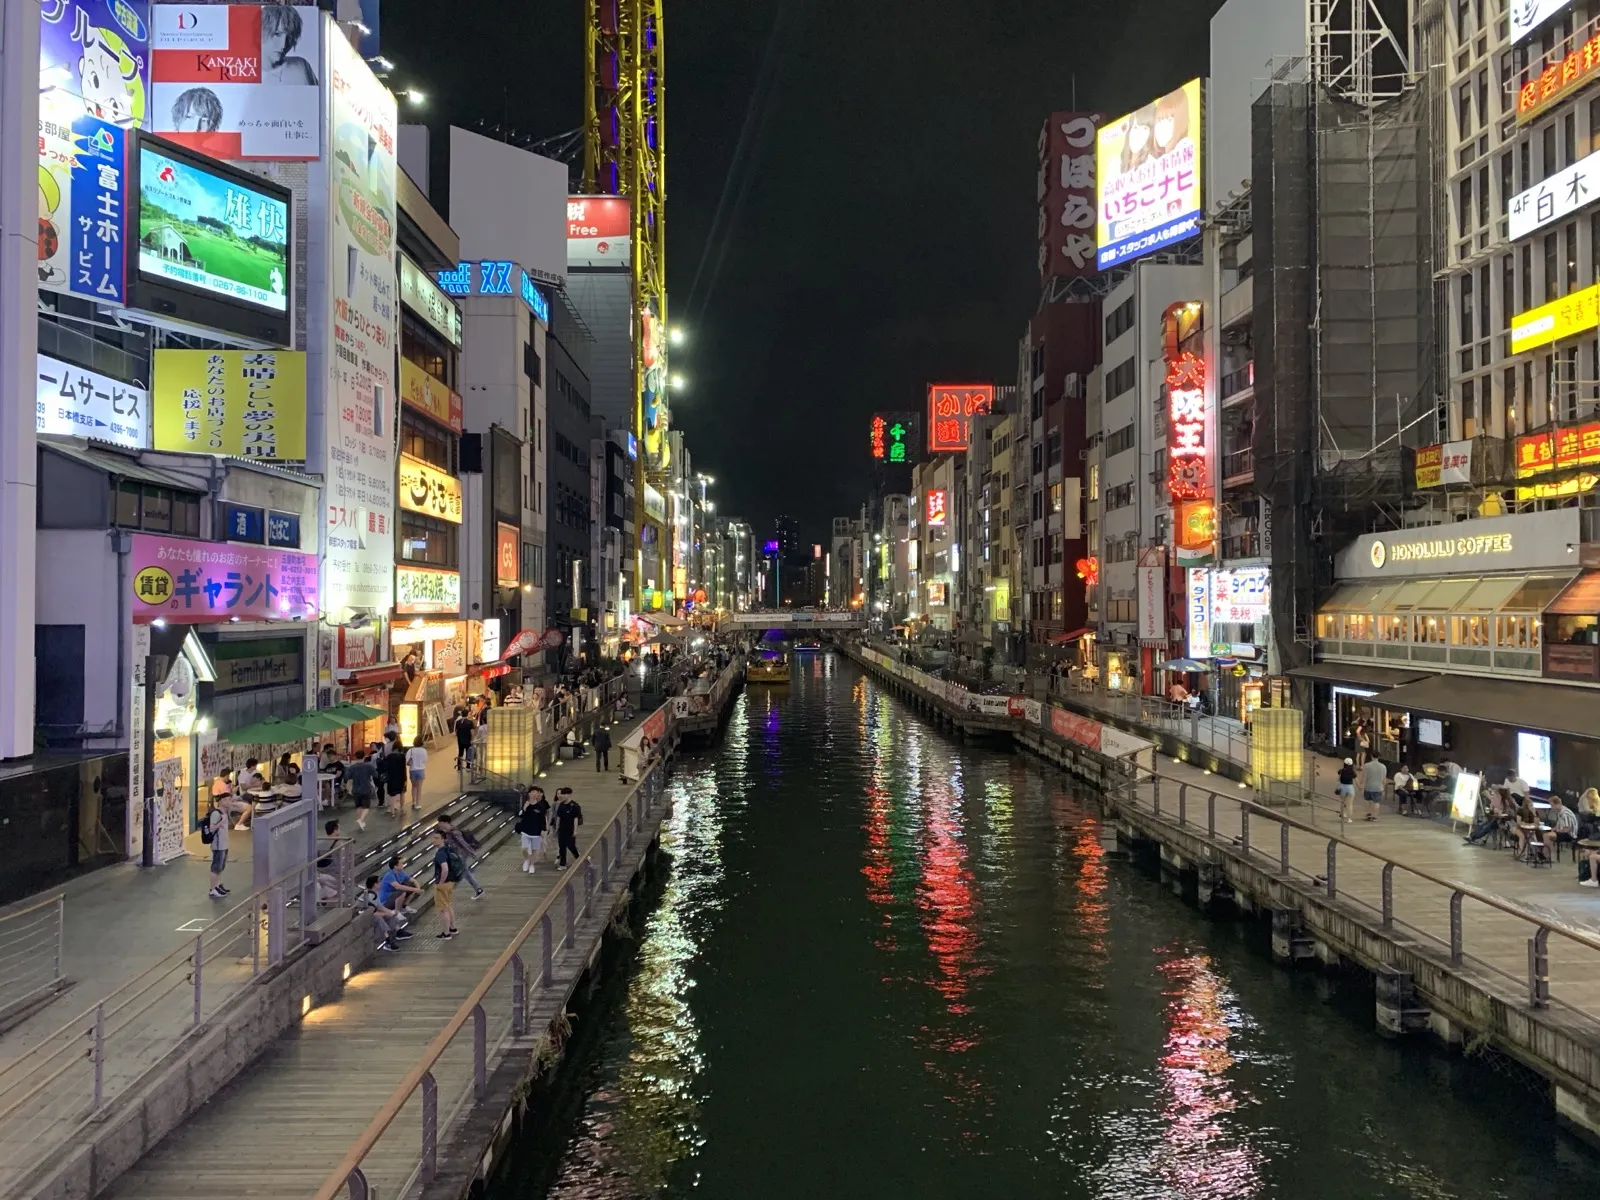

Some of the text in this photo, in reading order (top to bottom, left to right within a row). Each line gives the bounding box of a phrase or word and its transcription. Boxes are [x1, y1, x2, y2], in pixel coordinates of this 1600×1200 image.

[196, 54, 257, 71] KANZAKI
[220, 65, 257, 80] RUKA
[1513, 172, 1589, 223] 4F 白木
[96, 164, 120, 298] 富士ホーム
[570, 224, 599, 236] Free
[78, 216, 93, 286] サービス
[207, 354, 225, 449] あなたのお店づくり
[242, 353, 277, 458] 素晴らしい夢の実現
[59, 407, 93, 426] 日本橋支店
[182, 388, 202, 441] 応援します
[937, 419, 968, 443] 道
[1443, 453, 1468, 470] 営業中
[236, 512, 247, 537] 酒
[268, 517, 290, 541] たばこ
[1391, 532, 1513, 561] HONOLULU COFFEE
[140, 575, 169, 596] 賃貸
[175, 567, 279, 609] ギャラント
[170, 599, 178, 610] の
[1230, 606, 1251, 620] 免税
[231, 660, 288, 684] FamilyMart
